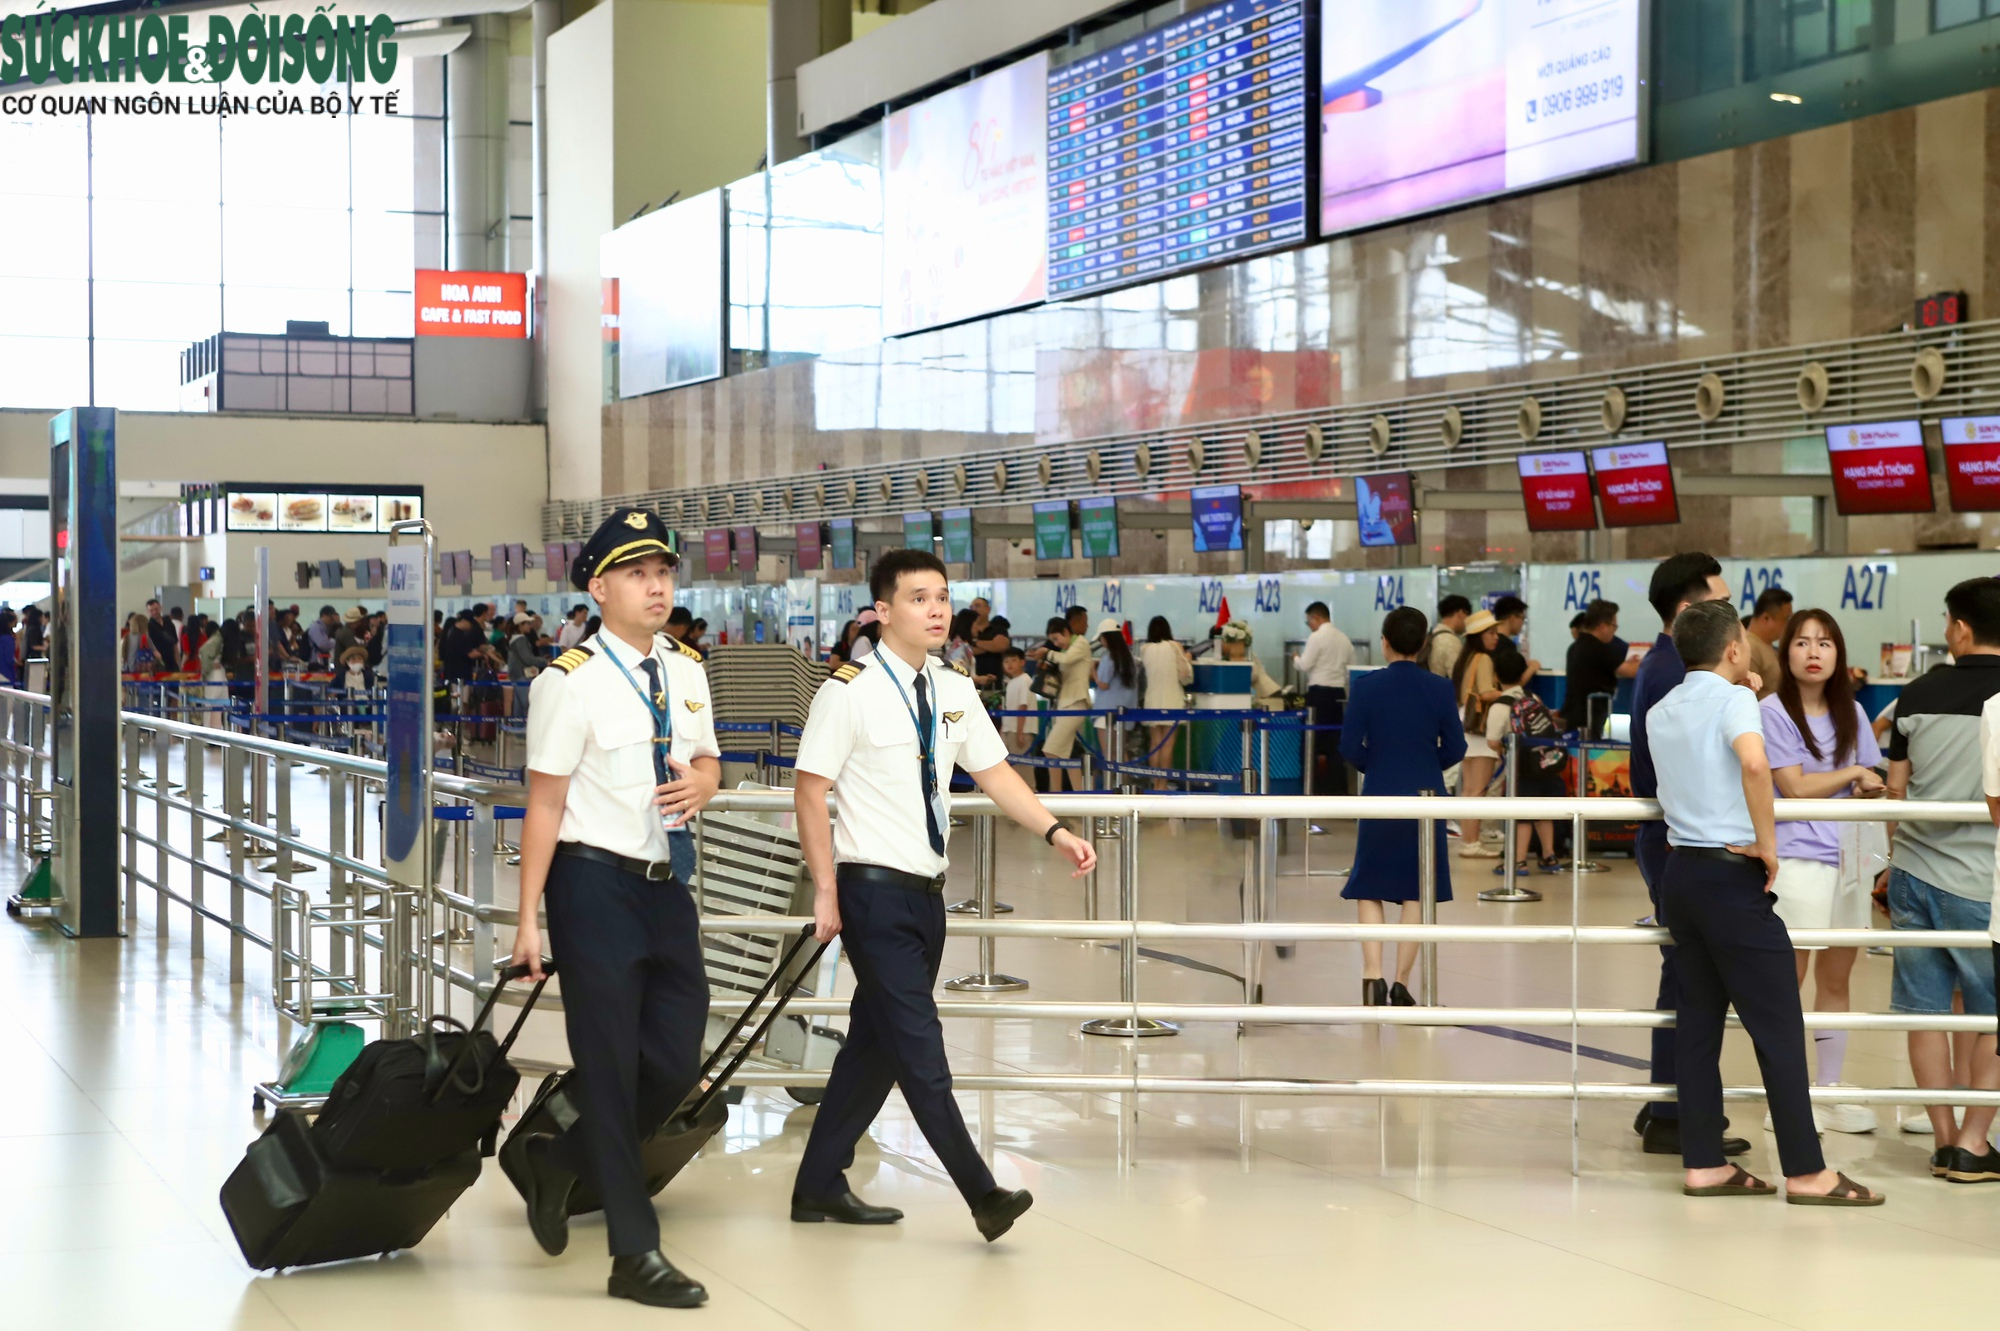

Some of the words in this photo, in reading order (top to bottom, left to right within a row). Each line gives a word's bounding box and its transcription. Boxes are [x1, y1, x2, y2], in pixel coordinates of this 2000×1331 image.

[1542, 89, 1572, 117] 0906
[1574, 81, 1599, 108] 999
[1601, 74, 1623, 101] 919
[441, 284, 470, 302] HOA
[472, 285, 502, 303] ANH
[421, 307, 450, 323] CAFE
[452, 309, 462, 323] &
[463, 309, 491, 325] FAST
[492, 310, 522, 325] FOOD
[1055, 584, 1077, 614] A20
[1101, 582, 1122, 613] A21
[1198, 581, 1224, 613] A22
[1254, 580, 1281, 613] A23
[1374, 575, 1405, 612] A24
[1564, 570, 1601, 611] A25
[1841, 564, 1888, 611] A27
